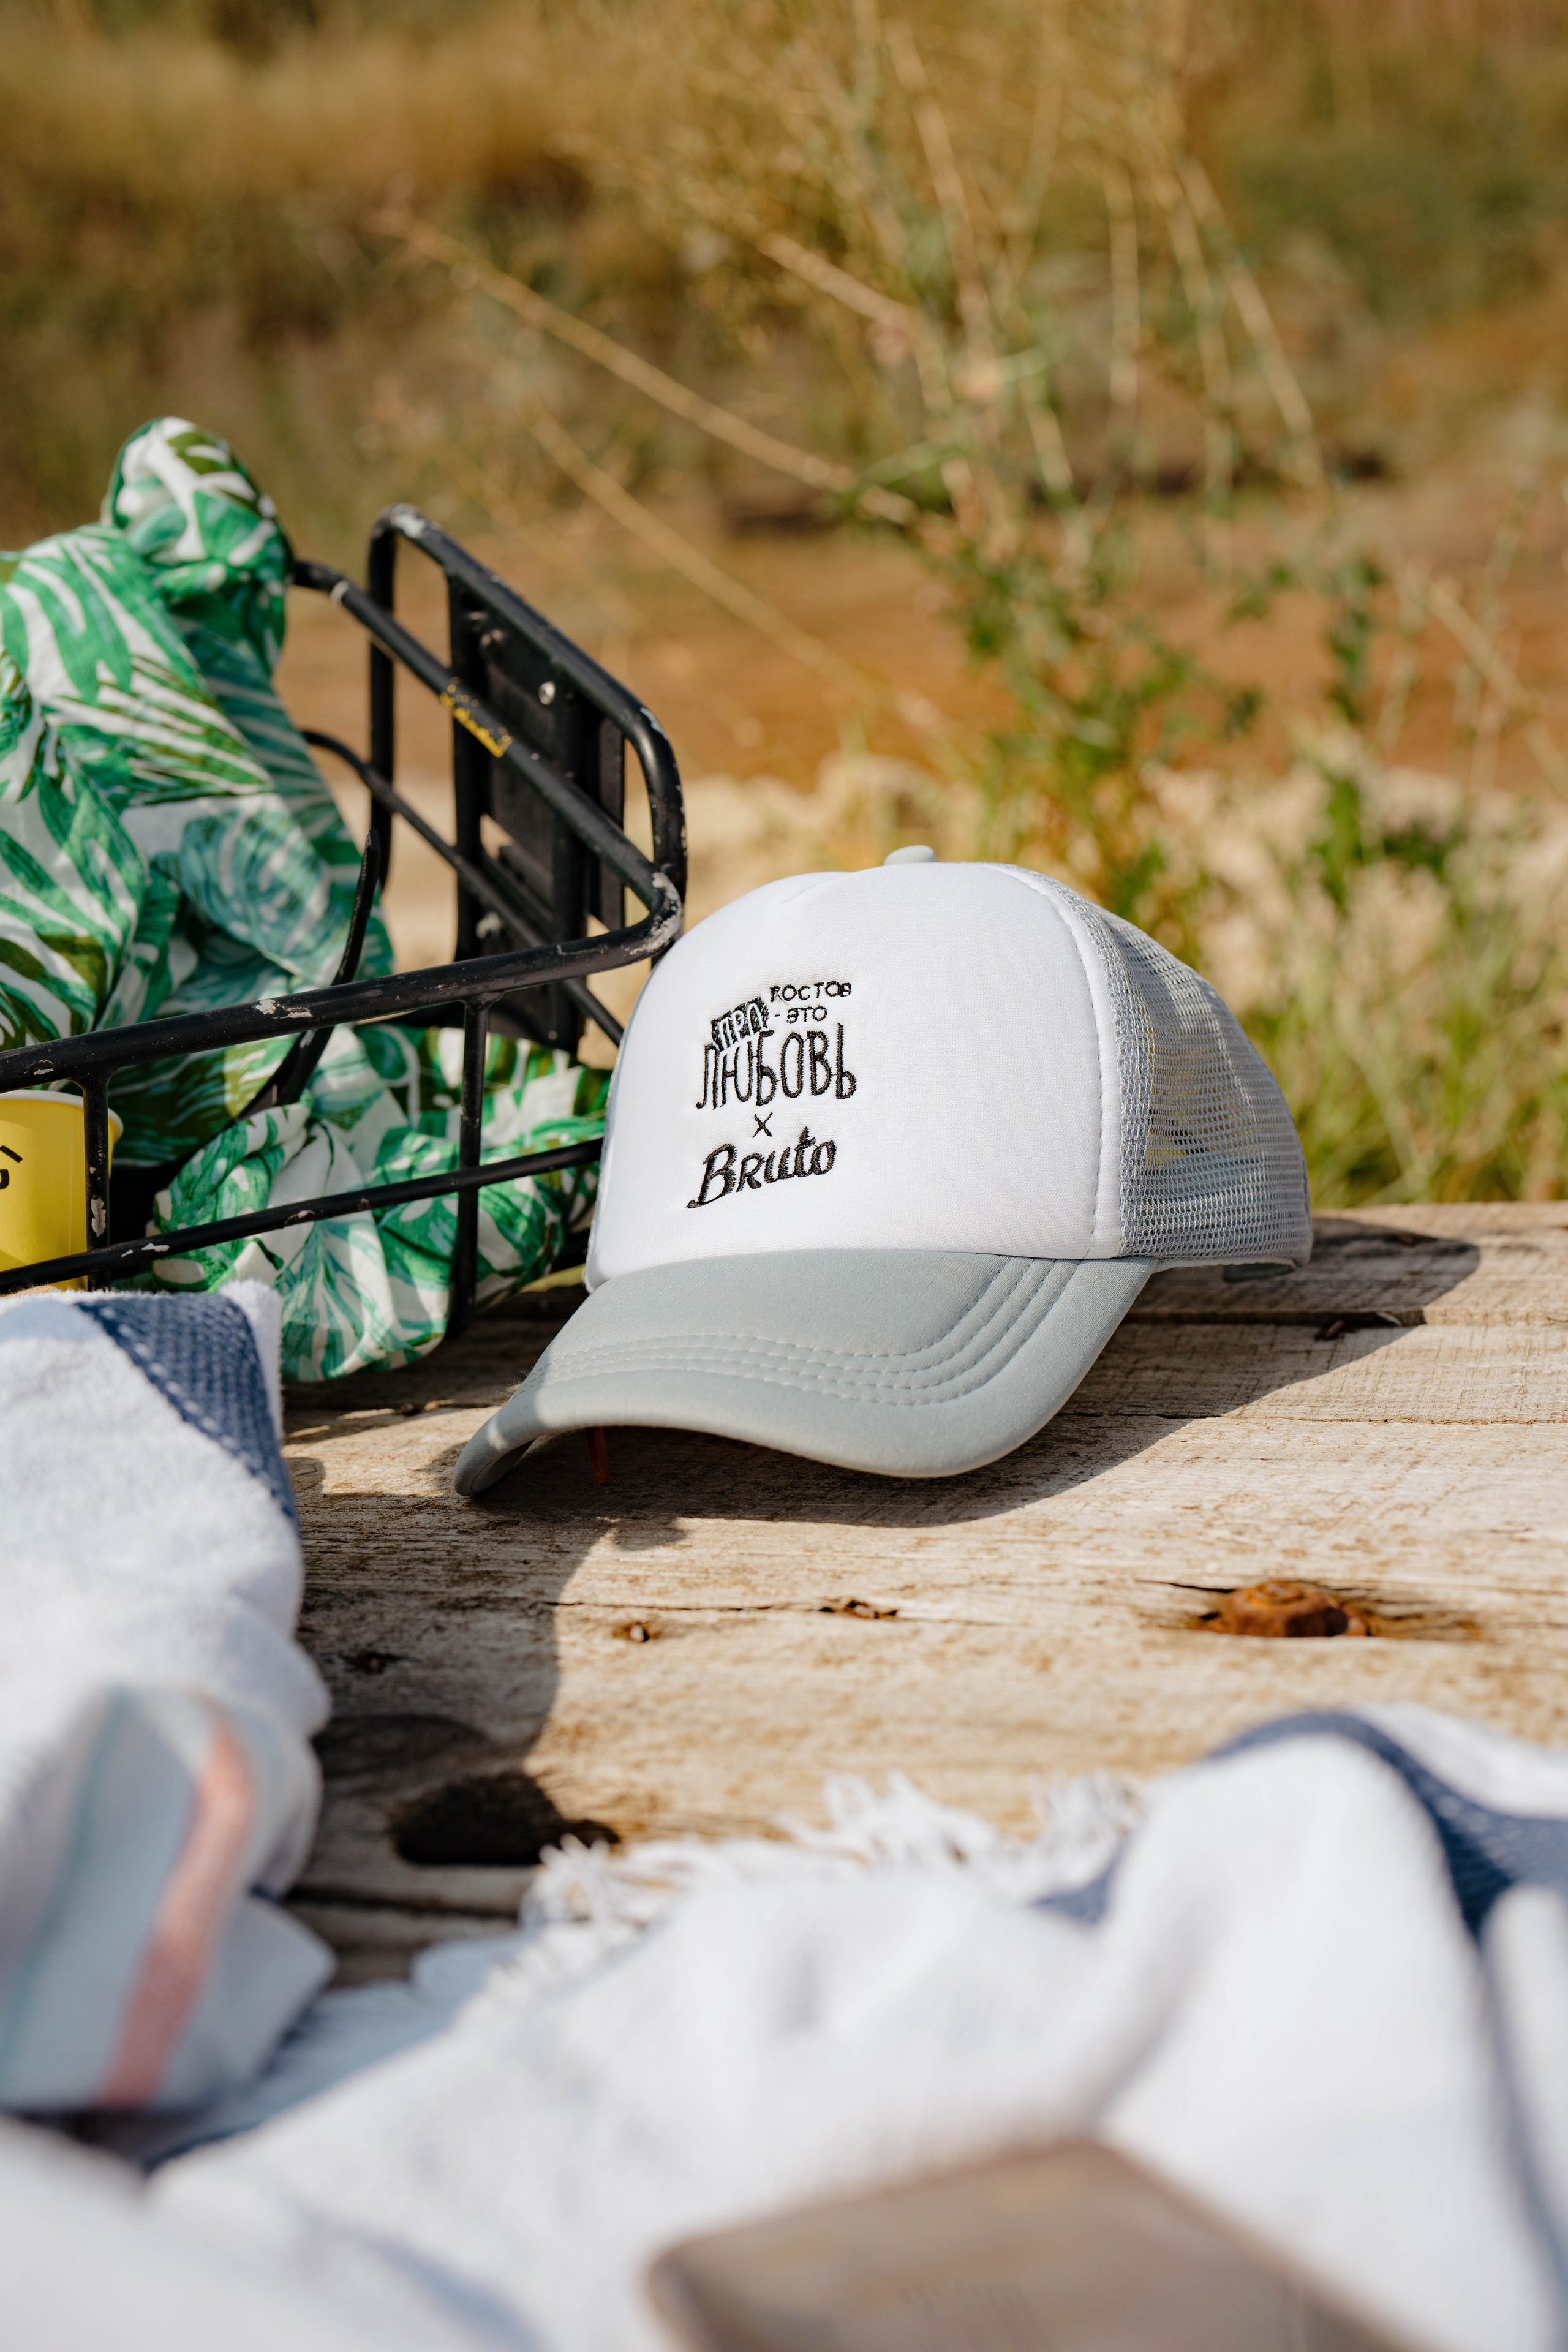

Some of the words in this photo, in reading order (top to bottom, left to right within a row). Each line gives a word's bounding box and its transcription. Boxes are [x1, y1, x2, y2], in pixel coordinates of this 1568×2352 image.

[769, 981, 852, 1003] РОСТОВ
[786, 1005, 828, 1024] ЭТО
[696, 1023, 858, 1110] ЛЮБОВЬ
